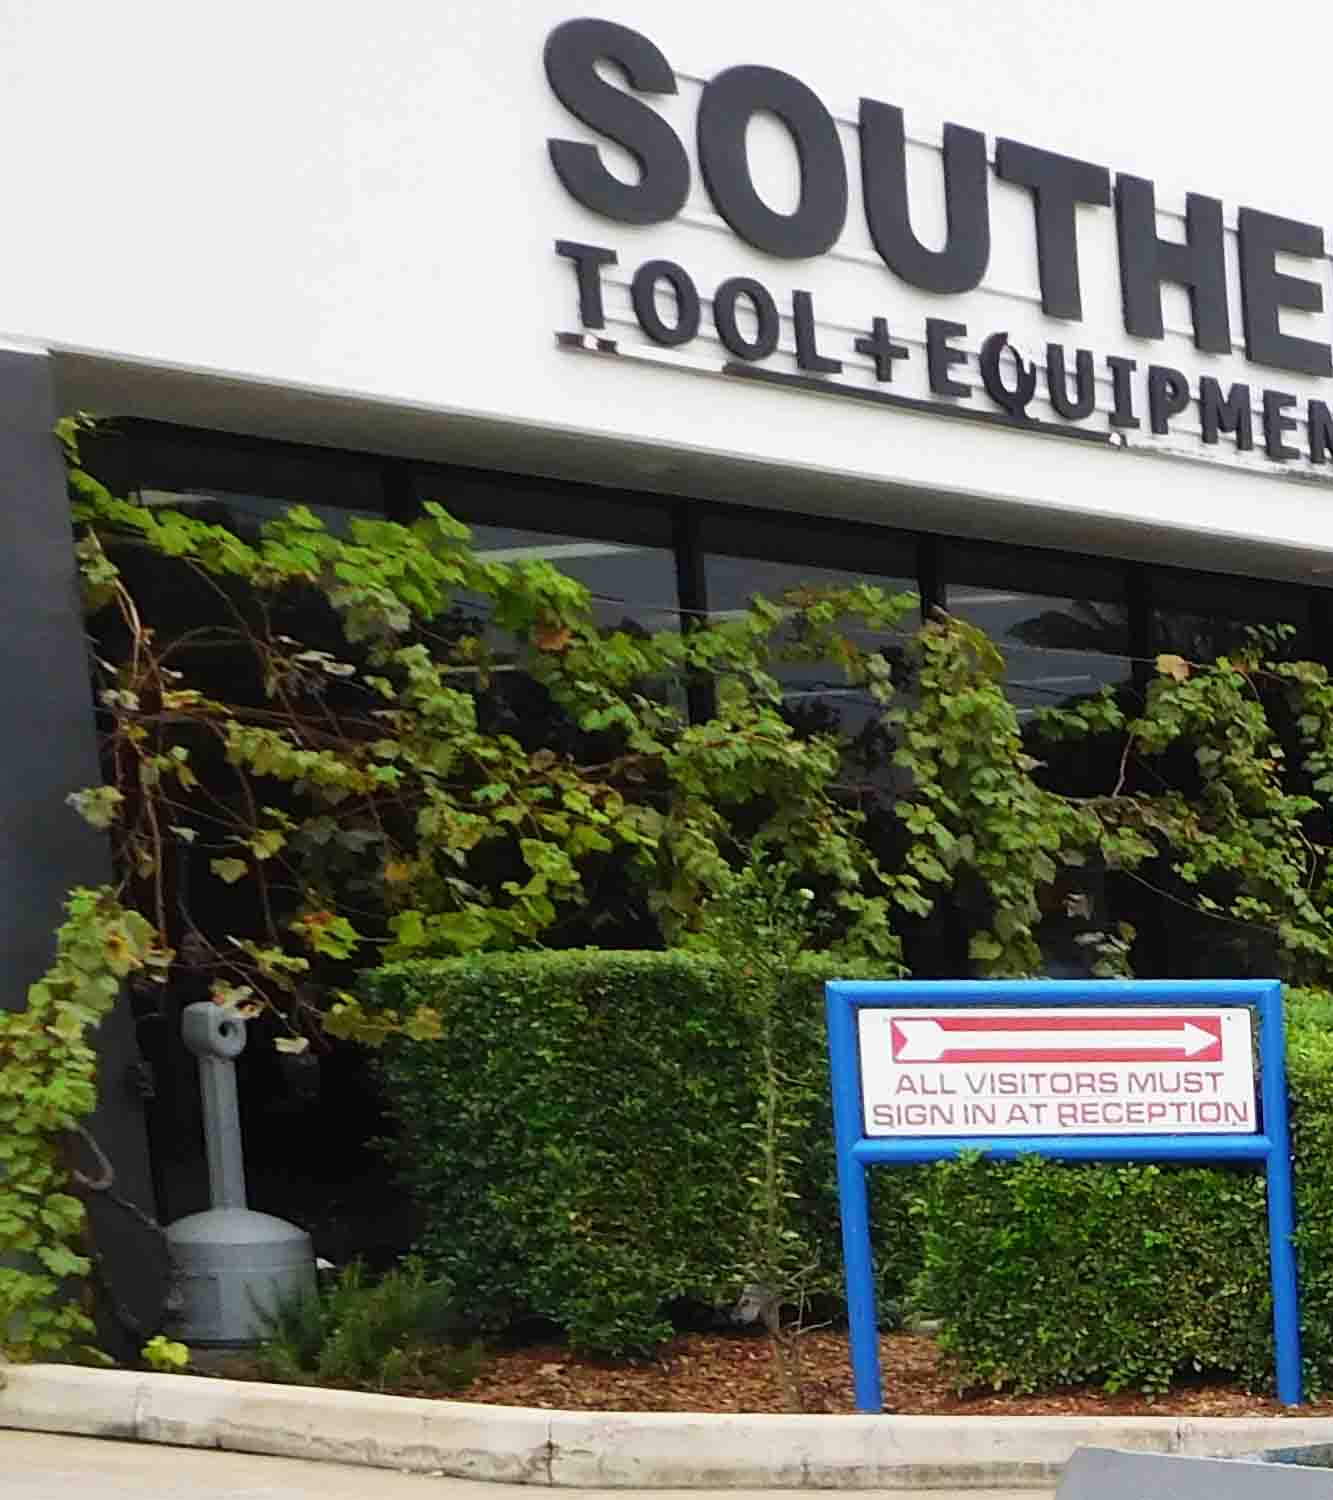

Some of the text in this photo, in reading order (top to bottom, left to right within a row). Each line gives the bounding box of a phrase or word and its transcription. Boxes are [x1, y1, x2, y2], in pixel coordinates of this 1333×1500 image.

[895, 1070, 1225, 1096] ALL VISITORS MUST
[872, 1101, 1250, 1128] SIGN IN AT RECEPTION
